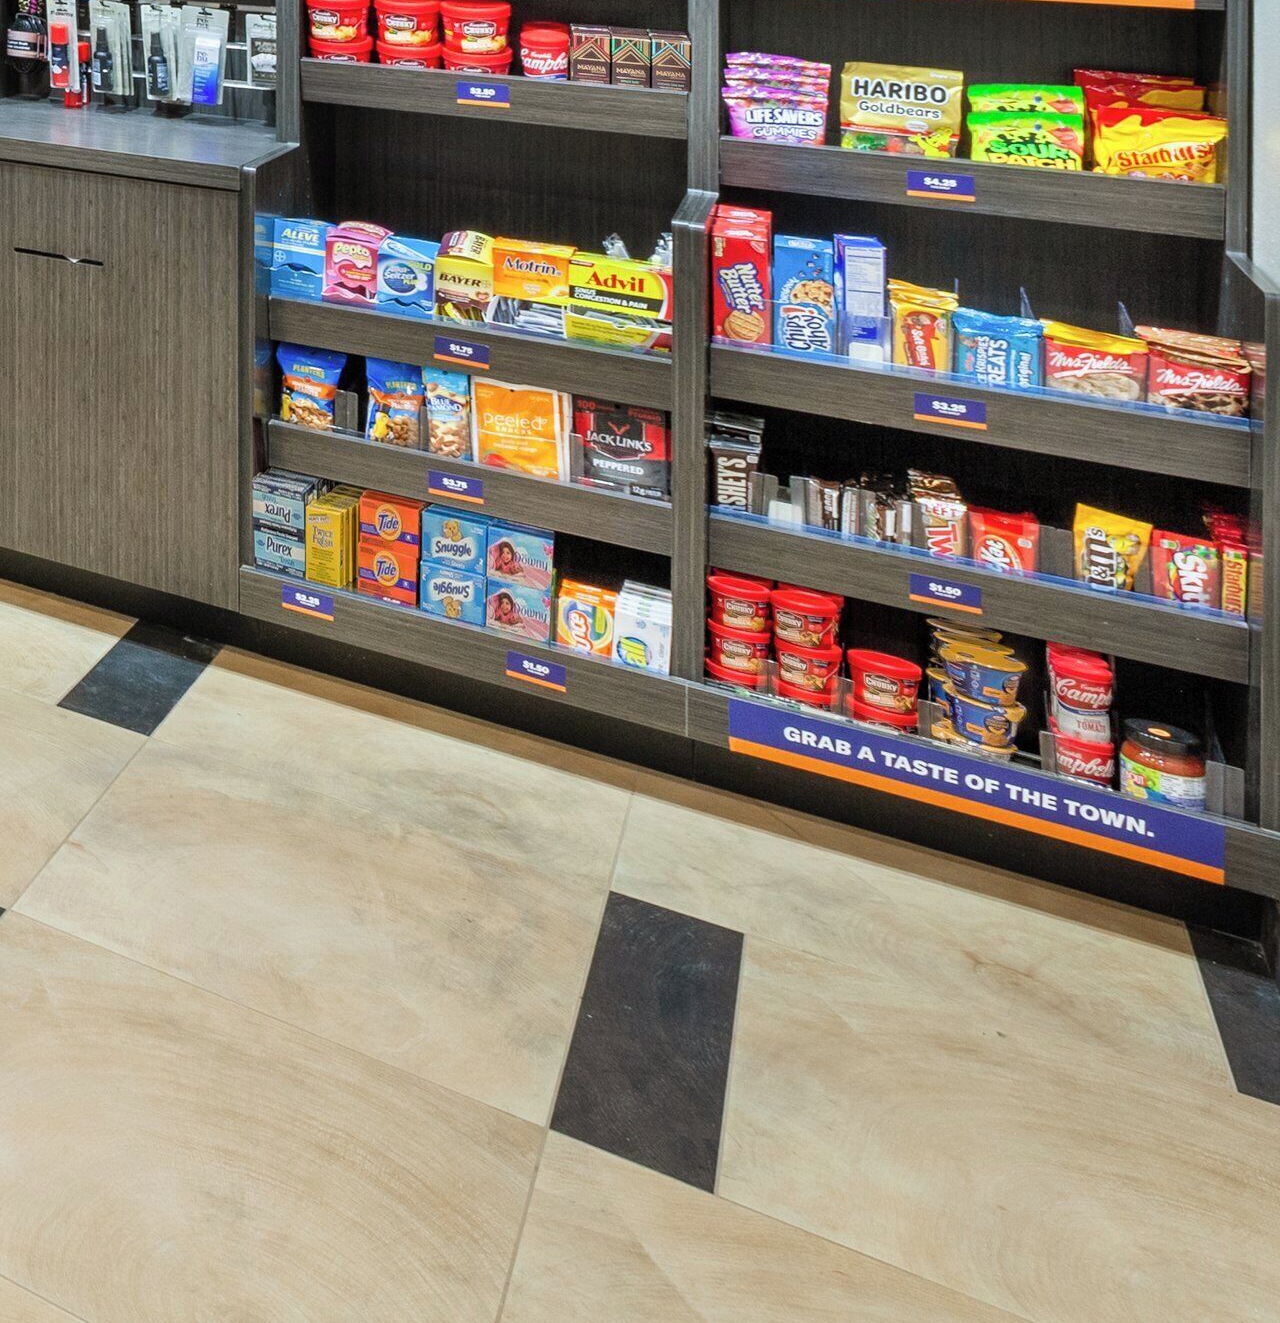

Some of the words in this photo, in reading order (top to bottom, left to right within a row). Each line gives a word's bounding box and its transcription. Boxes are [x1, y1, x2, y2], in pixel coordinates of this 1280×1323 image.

[312, 13, 339, 25] CHUNKY
[386, 18, 415, 30] CHUNKY
[463, 24, 495, 37] CHUNKY
[578, 64, 605, 72] MAYANA
[616, 67, 645, 75] MAYANA
[852, 78, 947, 104] HARIBO
[858, 100, 941, 120] Goldbears
[753, 126, 816, 141] GUMMIES
[989, 139, 1068, 160] SOUR
[1117, 141, 1217, 168] Starburst
[924, 176, 957, 189] $4.25
[282, 228, 320, 241] ALEVE
[504, 256, 556, 275] Motrin
[440, 273, 481, 286] BAYER
[586, 271, 644, 293] Advil
[734, 262, 765, 311] Nutter
[575, 287, 596, 295] SINUS
[719, 268, 751, 315] Butter
[574, 293, 622, 305] CONGESTION
[630, 300, 648, 310] PAIN
[783, 314, 812, 351] Chips
[450, 343, 473, 355] $1.75
[932, 400, 967, 413] $3.25
[483, 412, 548, 430] peeled
[585, 431, 614, 446] JACK
[616, 436, 652, 452] LINK'S
[593, 458, 644, 476] PEPPERED
[442, 477, 467, 489] $3.75
[265, 503, 290, 522] Purex
[925, 505, 958, 518] LEFT
[378, 515, 398, 531] Tide
[267, 536, 292, 557] Purex
[435, 540, 472, 559] Snuggle
[376, 560, 397, 576] Tide
[513, 552, 549, 573] Downy
[433, 583, 470, 598] Snuggle
[929, 582, 961, 596] $1.50
[513, 602, 549, 624] Downy
[726, 604, 755, 615] CHUNKY
[723, 645, 752, 656] CHUNKY
[523, 660, 550, 676] $1.50
[865, 678, 898, 692] CHUNKY
[783, 725, 852, 756] GRAB
[856, 744, 876, 762] A
[884, 749, 959, 784] TASTE
[964, 773, 1000, 794] OF
[1005, 784, 1058, 811] THE
[1063, 798, 1155, 837] TOWN.
